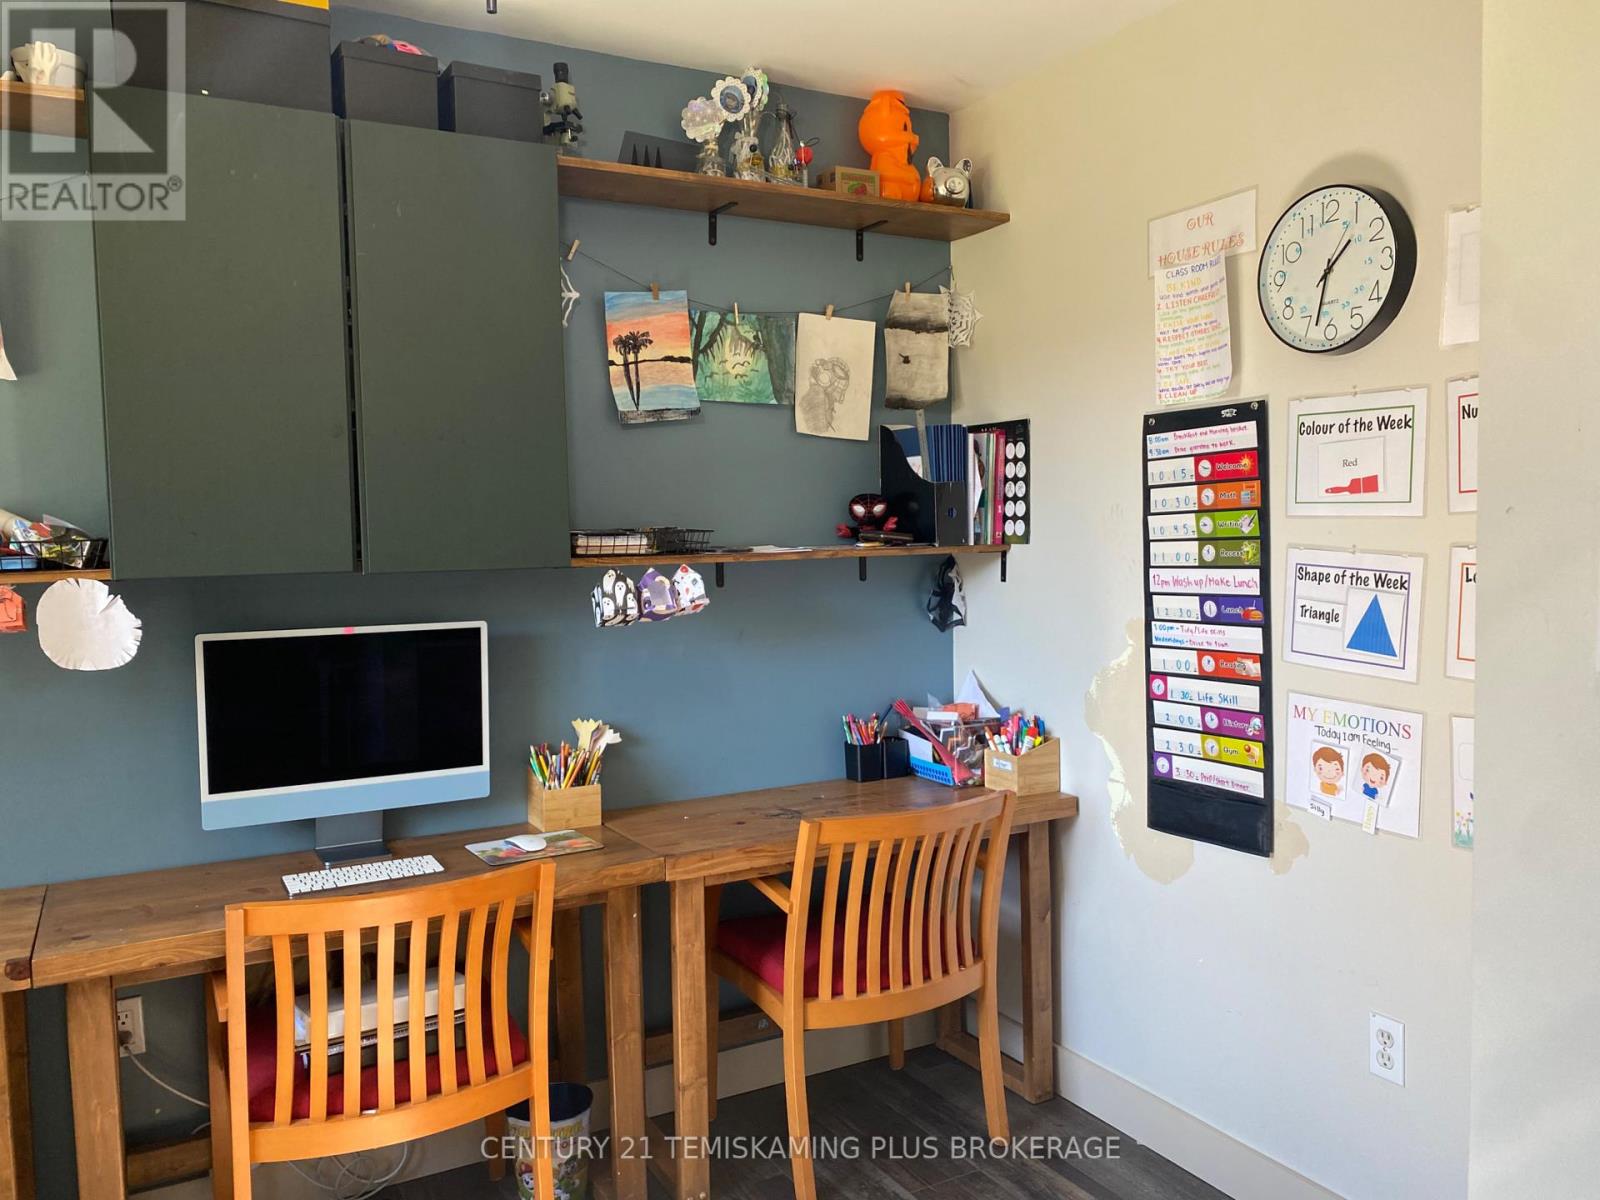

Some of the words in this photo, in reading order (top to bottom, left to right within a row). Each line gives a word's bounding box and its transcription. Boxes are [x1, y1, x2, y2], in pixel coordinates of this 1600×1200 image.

[1186, 211, 1214, 231] OUR
[1321, 199, 1340, 225] 12
[1301, 214, 1314, 239] 11
[1368, 216, 1385, 242] 2
[1157, 245, 1200, 267] HOUSE
[1202, 231, 1245, 256] RULES
[1281, 241, 1302, 266] 10
[1380, 246, 1394, 271] 3
[1165, 267, 1189, 279] CLASS
[1273, 270, 1286, 294] 9
[1368, 280, 1383, 303] 4
[1282, 296, 1295, 321] 8
[1350, 305, 1364, 331] 5
[1300, 314, 1312, 338] 7
[1323, 318, 1338, 341] 6
[1299, 419, 1335, 437] Colour
[1338, 418, 1351, 433] of
[1353, 416, 1373, 433] the
[1376, 413, 1413, 432] Week
[1342, 458, 1358, 468] Red
[1152, 574, 1171, 588] 12pm
[1172, 575, 1193, 588] Wash
[1233, 575, 1258, 589] Lunch
[1297, 567, 1331, 584] Shape
[1334, 570, 1347, 585] of
[1349, 572, 1370, 588] the
[1373, 573, 1409, 591] Week
[1299, 604, 1340, 624] Triangle
[1197, 691, 1213, 703] Life
[1294, 704, 1318, 722] MY
[1323, 709, 1412, 740] EMOTIONS
[1314, 725, 1341, 744] Today
[1343, 731, 1347, 741] I
[1348, 733, 1361, 742] am
[1223, 746, 1239, 755] Gym
